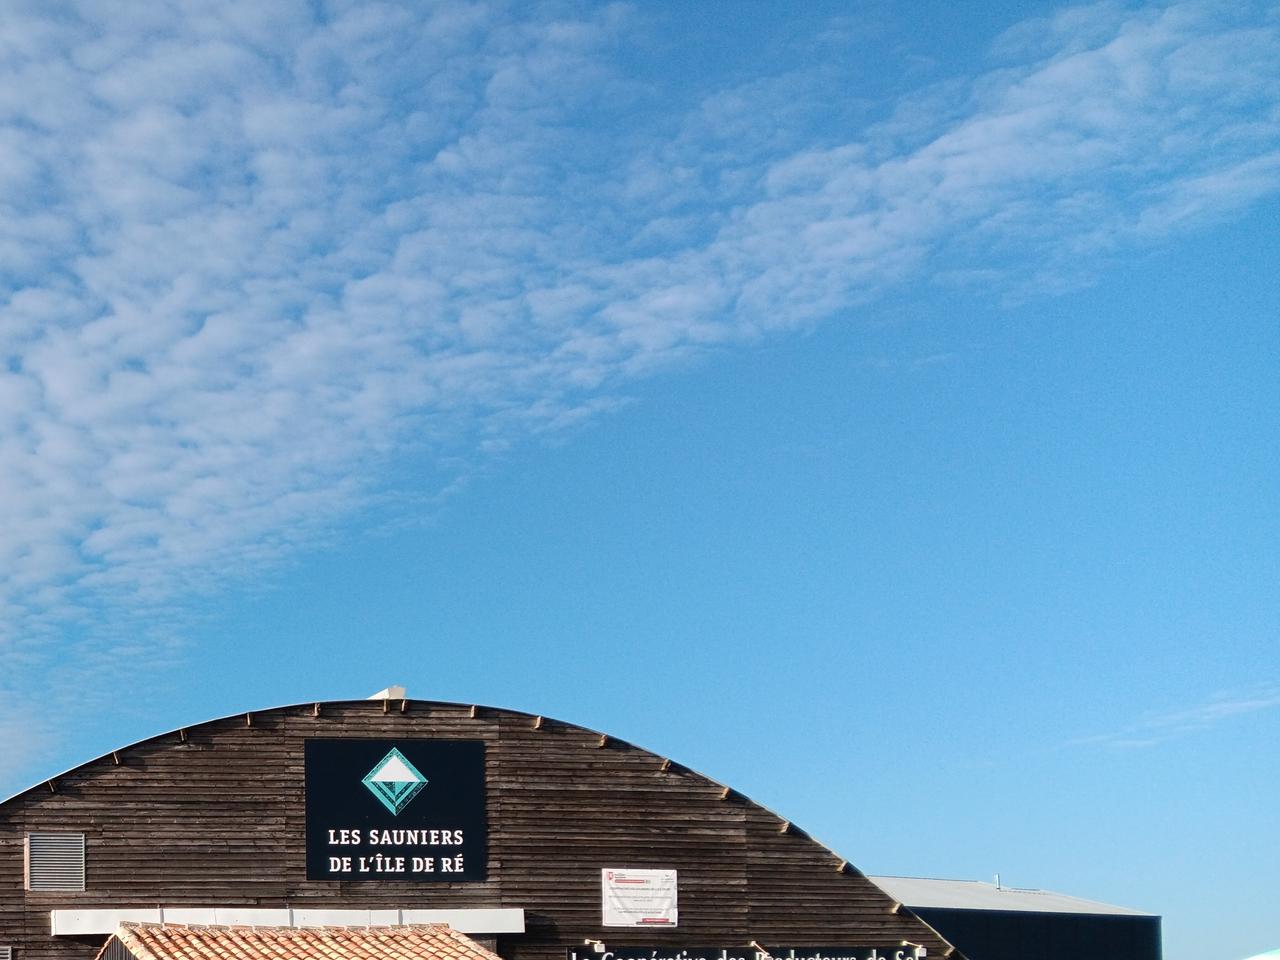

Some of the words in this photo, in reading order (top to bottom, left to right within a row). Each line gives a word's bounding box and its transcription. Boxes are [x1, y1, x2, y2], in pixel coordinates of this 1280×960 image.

[328, 829, 361, 845] LES
[369, 829, 464, 846] SAUNIERS
[329, 857, 352, 872] DE
[359, 853, 405, 872] L'ÎLE
[412, 857, 435, 872] DE
[441, 853, 465, 873] RÉ
